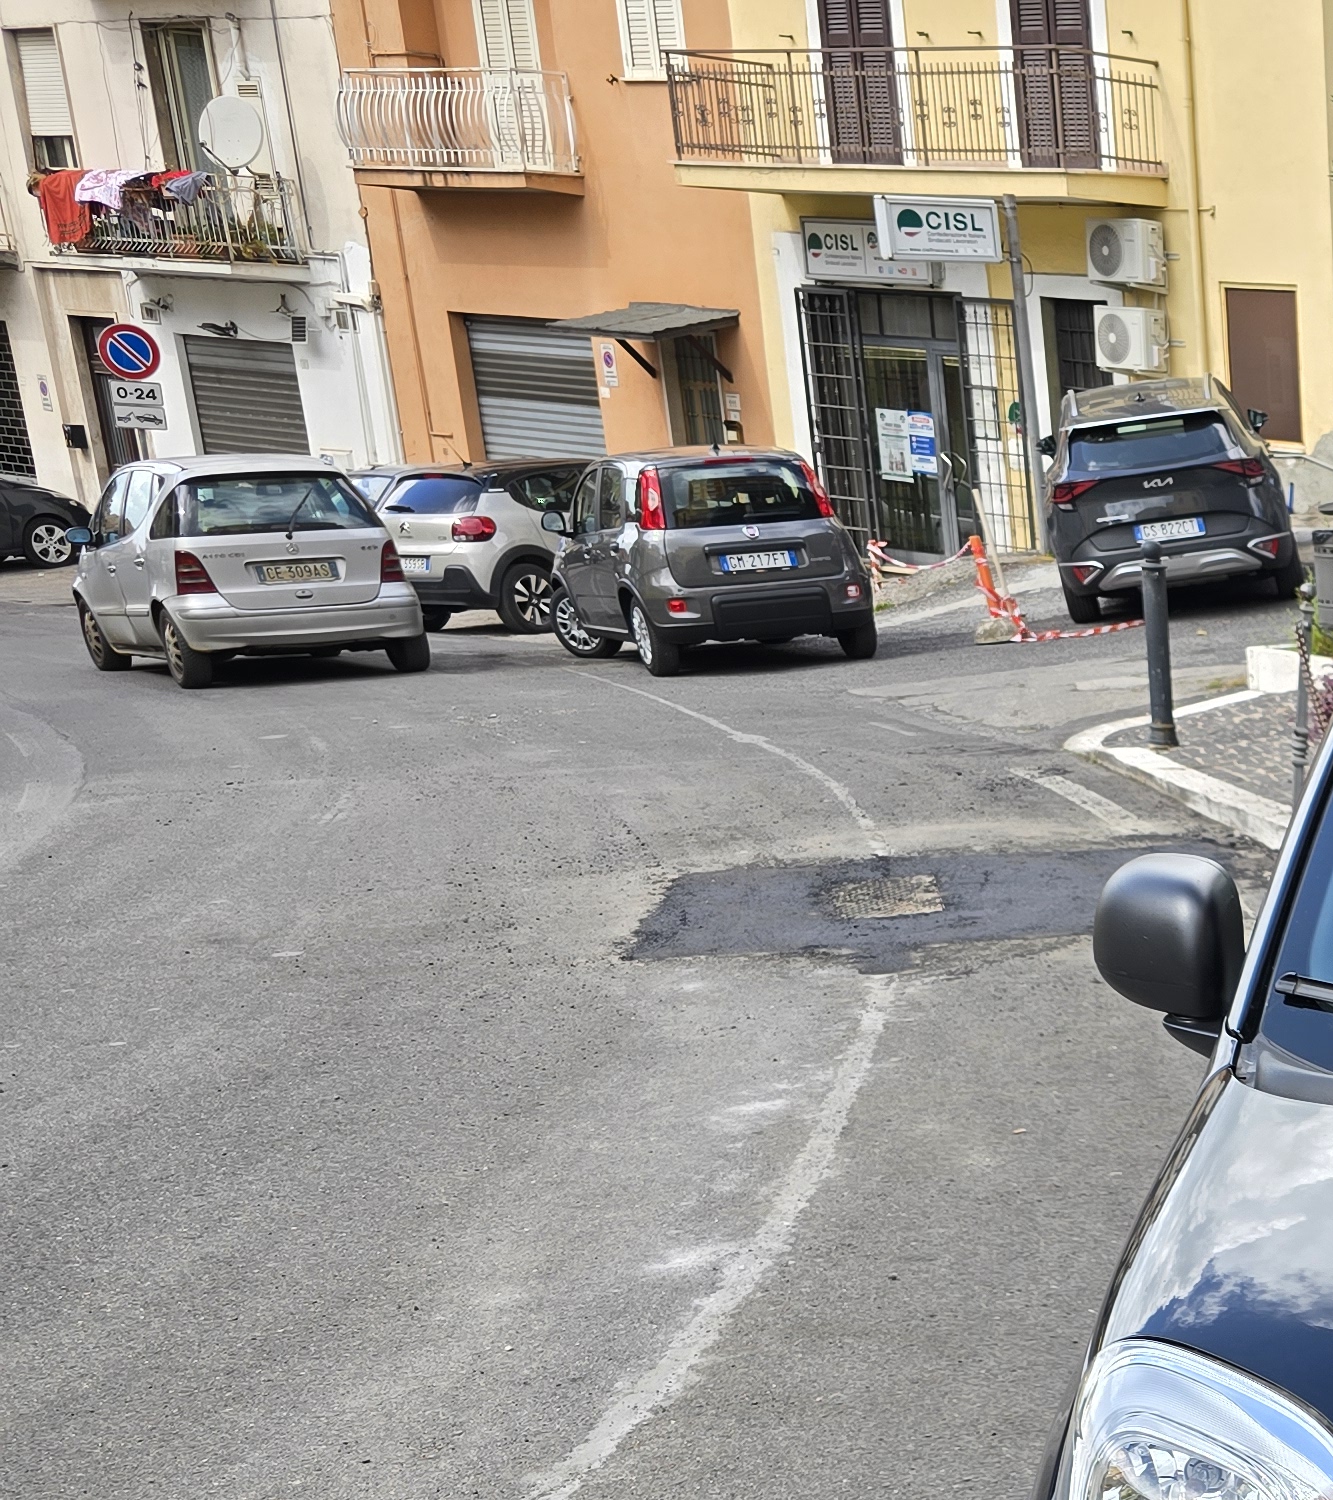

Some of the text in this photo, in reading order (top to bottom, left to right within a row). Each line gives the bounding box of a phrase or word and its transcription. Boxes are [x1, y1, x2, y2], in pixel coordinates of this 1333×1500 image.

[926, 211, 984, 232] CISL
[823, 234, 859, 251] CISL
[116, 386, 157, 400] 0-24
[748, 552, 787, 567] 217FT
[266, 563, 330, 580] CE 309AS
